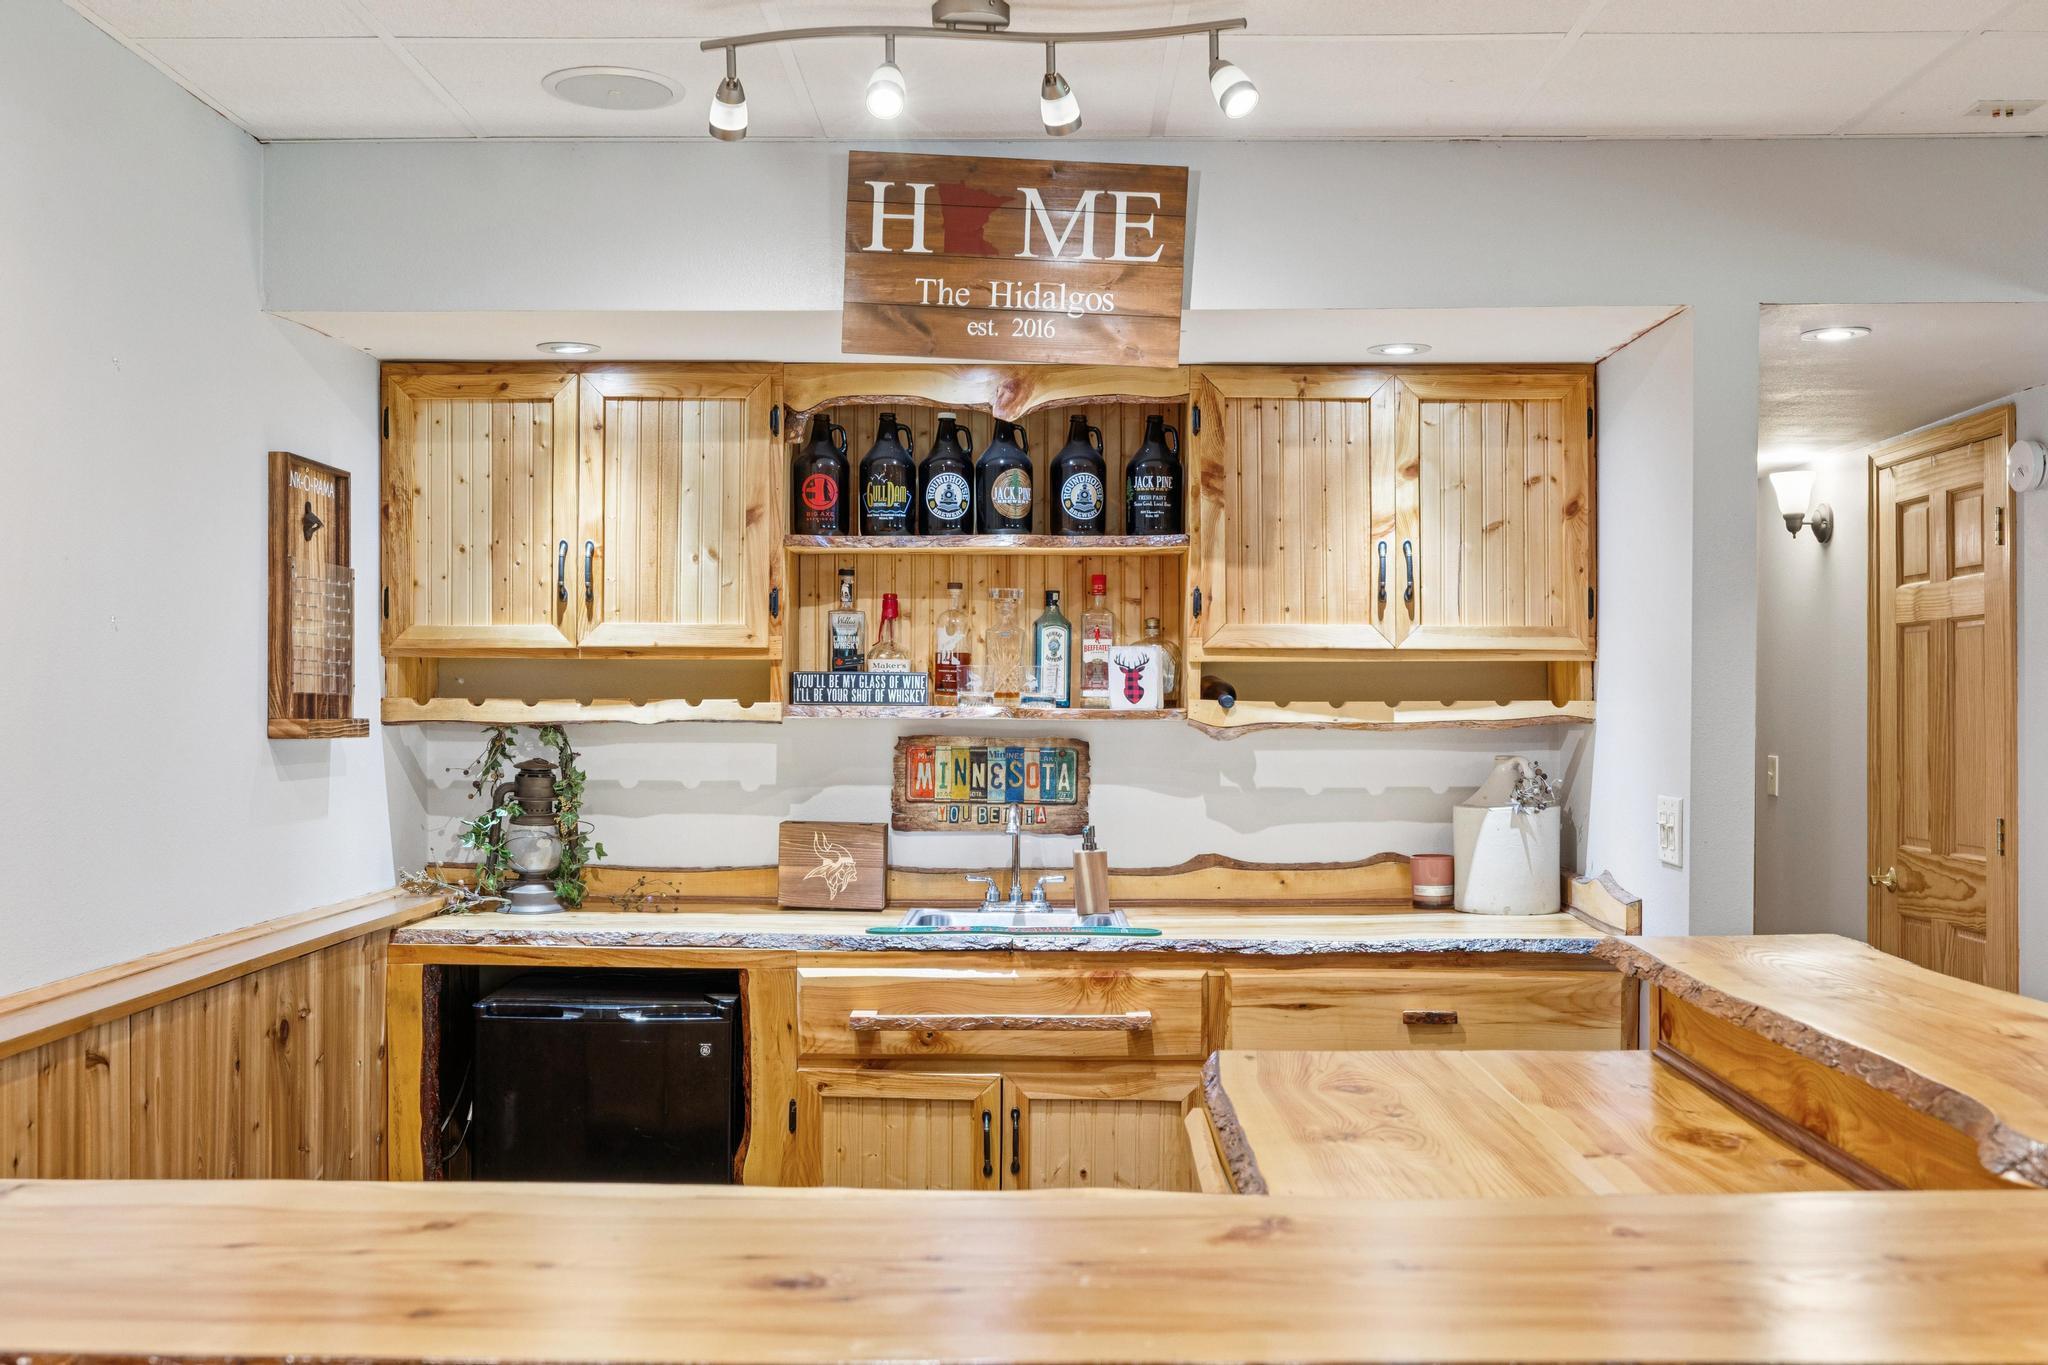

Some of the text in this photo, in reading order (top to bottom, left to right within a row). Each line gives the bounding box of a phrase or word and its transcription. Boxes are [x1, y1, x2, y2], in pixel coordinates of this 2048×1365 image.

[915, 278, 1115, 318] The Hidalgos
[966, 318, 1056, 338] est. 2016
[927, 475, 969, 501] ROUNDHOUSE
[1133, 475, 1174, 489] JACK PINE
[867, 481, 887, 508] GULL
[992, 486, 1016, 500] JACK
[932, 507, 963, 518] BREWERY
[1068, 507, 1098, 518] BREWERY
[796, 674, 826, 688] YOU'LL
[829, 675, 839, 688] BE
[842, 675, 856, 689] MY
[858, 675, 886, 689] GLASS
[889, 675, 900, 689] OF
[901, 675, 926, 690] WINE
[796, 688, 926, 703] I'LL BE YOUR SHOT OF WHISKEY
[915, 758, 1071, 791] MINNESOTA
[938, 805, 1046, 823] YOU BETHA
